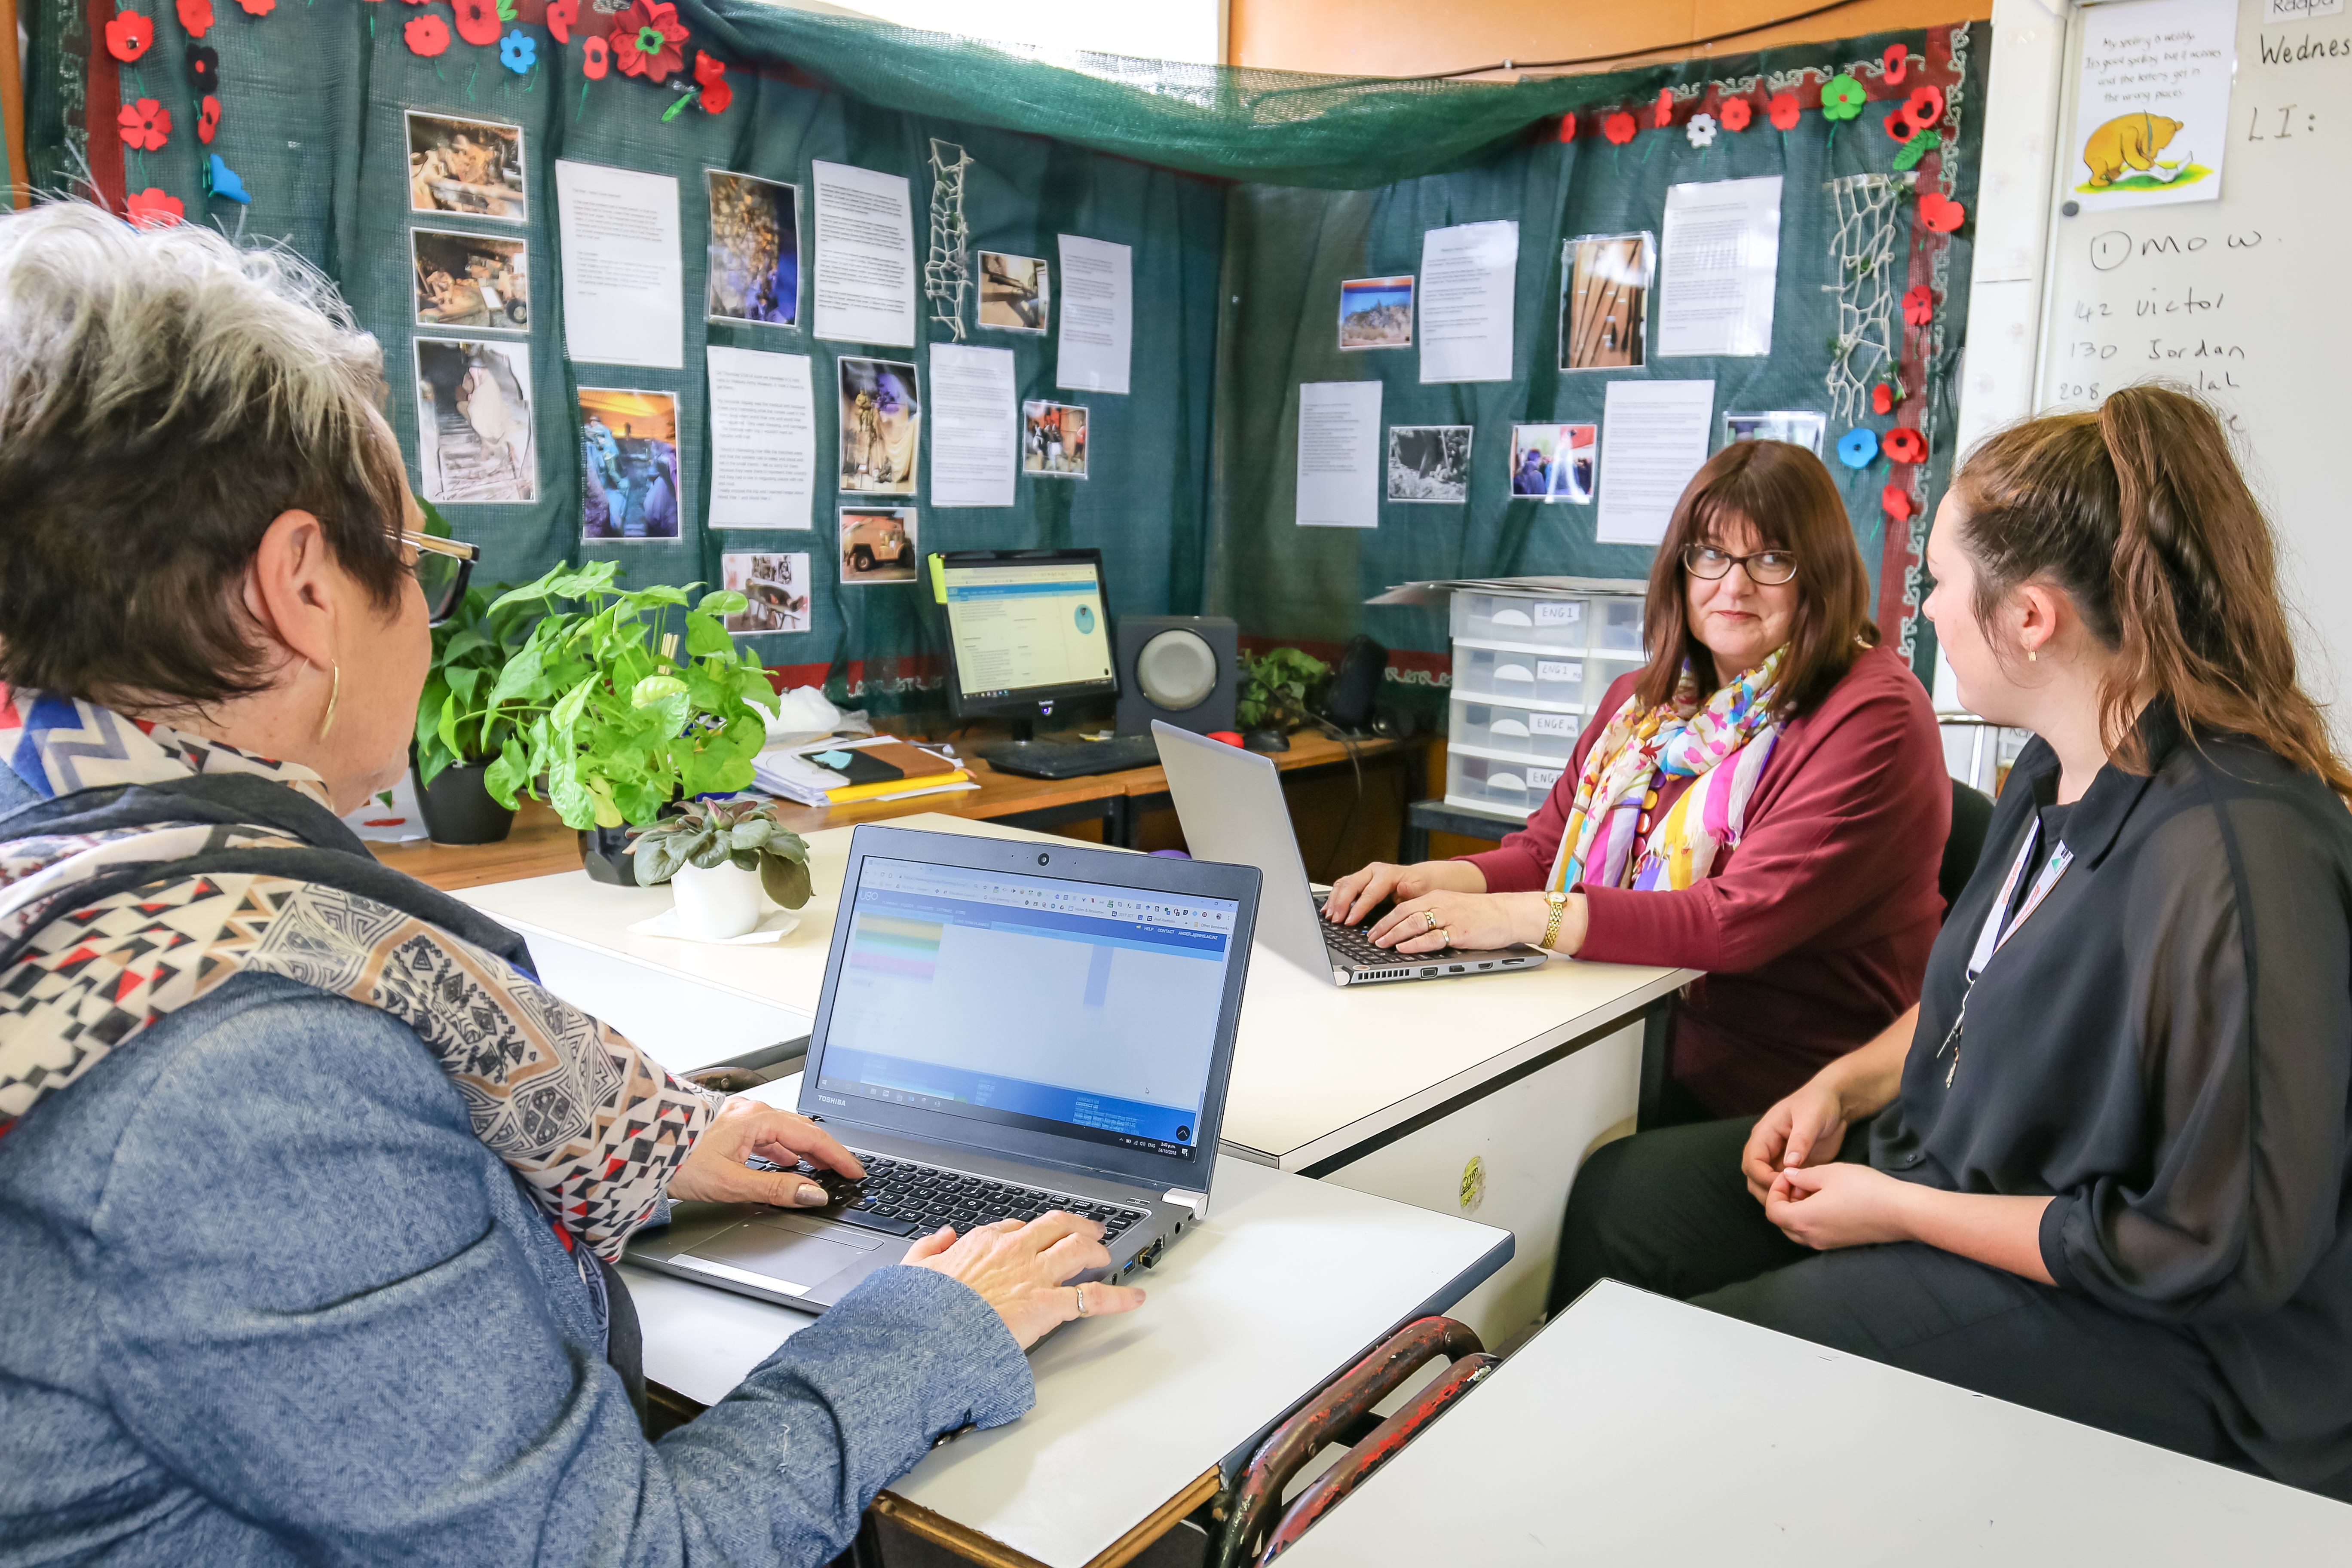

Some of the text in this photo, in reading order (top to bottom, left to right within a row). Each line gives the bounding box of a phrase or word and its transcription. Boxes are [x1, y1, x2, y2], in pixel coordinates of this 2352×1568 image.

[2071, 342, 2117, 359] 130
[2060, 383, 2100, 400] 208
[818, 1095, 846, 1106] TOSHIBA
